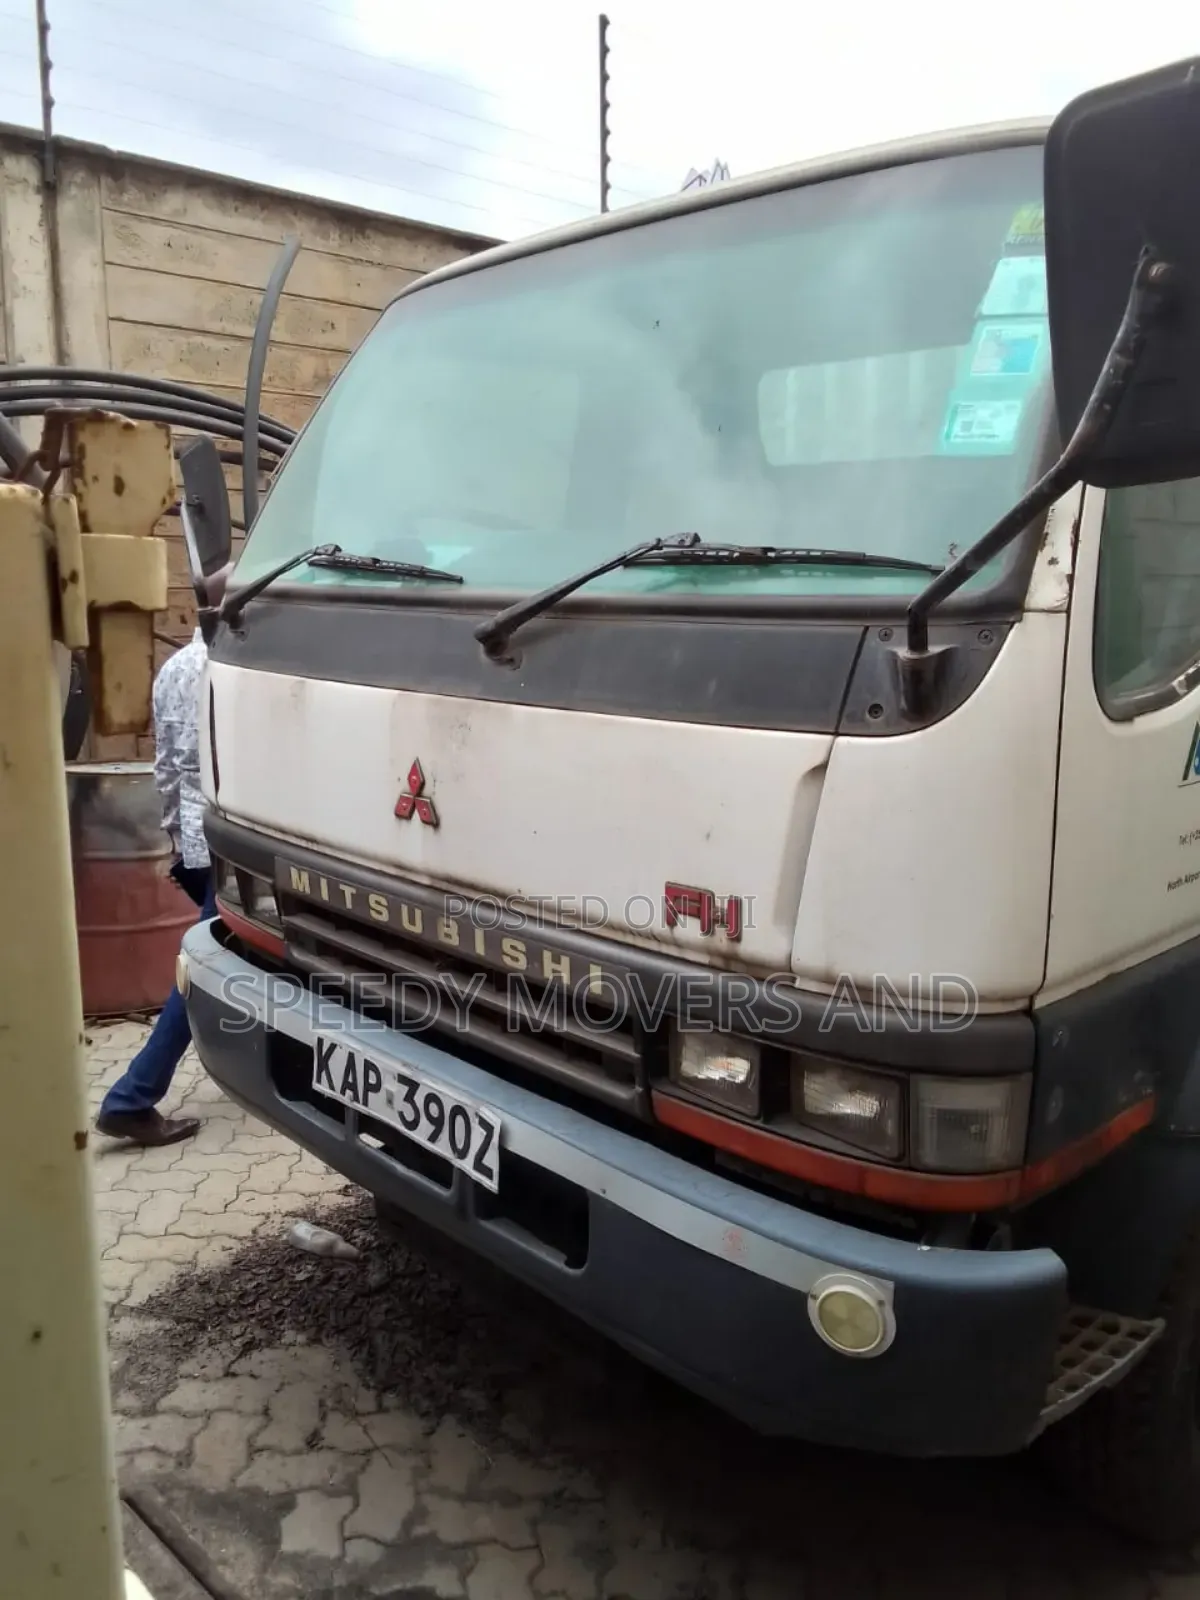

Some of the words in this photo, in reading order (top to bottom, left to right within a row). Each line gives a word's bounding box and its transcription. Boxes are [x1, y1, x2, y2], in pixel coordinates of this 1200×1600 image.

[289, 865, 605, 996] MITSUBISHI
[315, 1036, 382, 1108] KAP
[396, 1072, 495, 1181] 390Z
